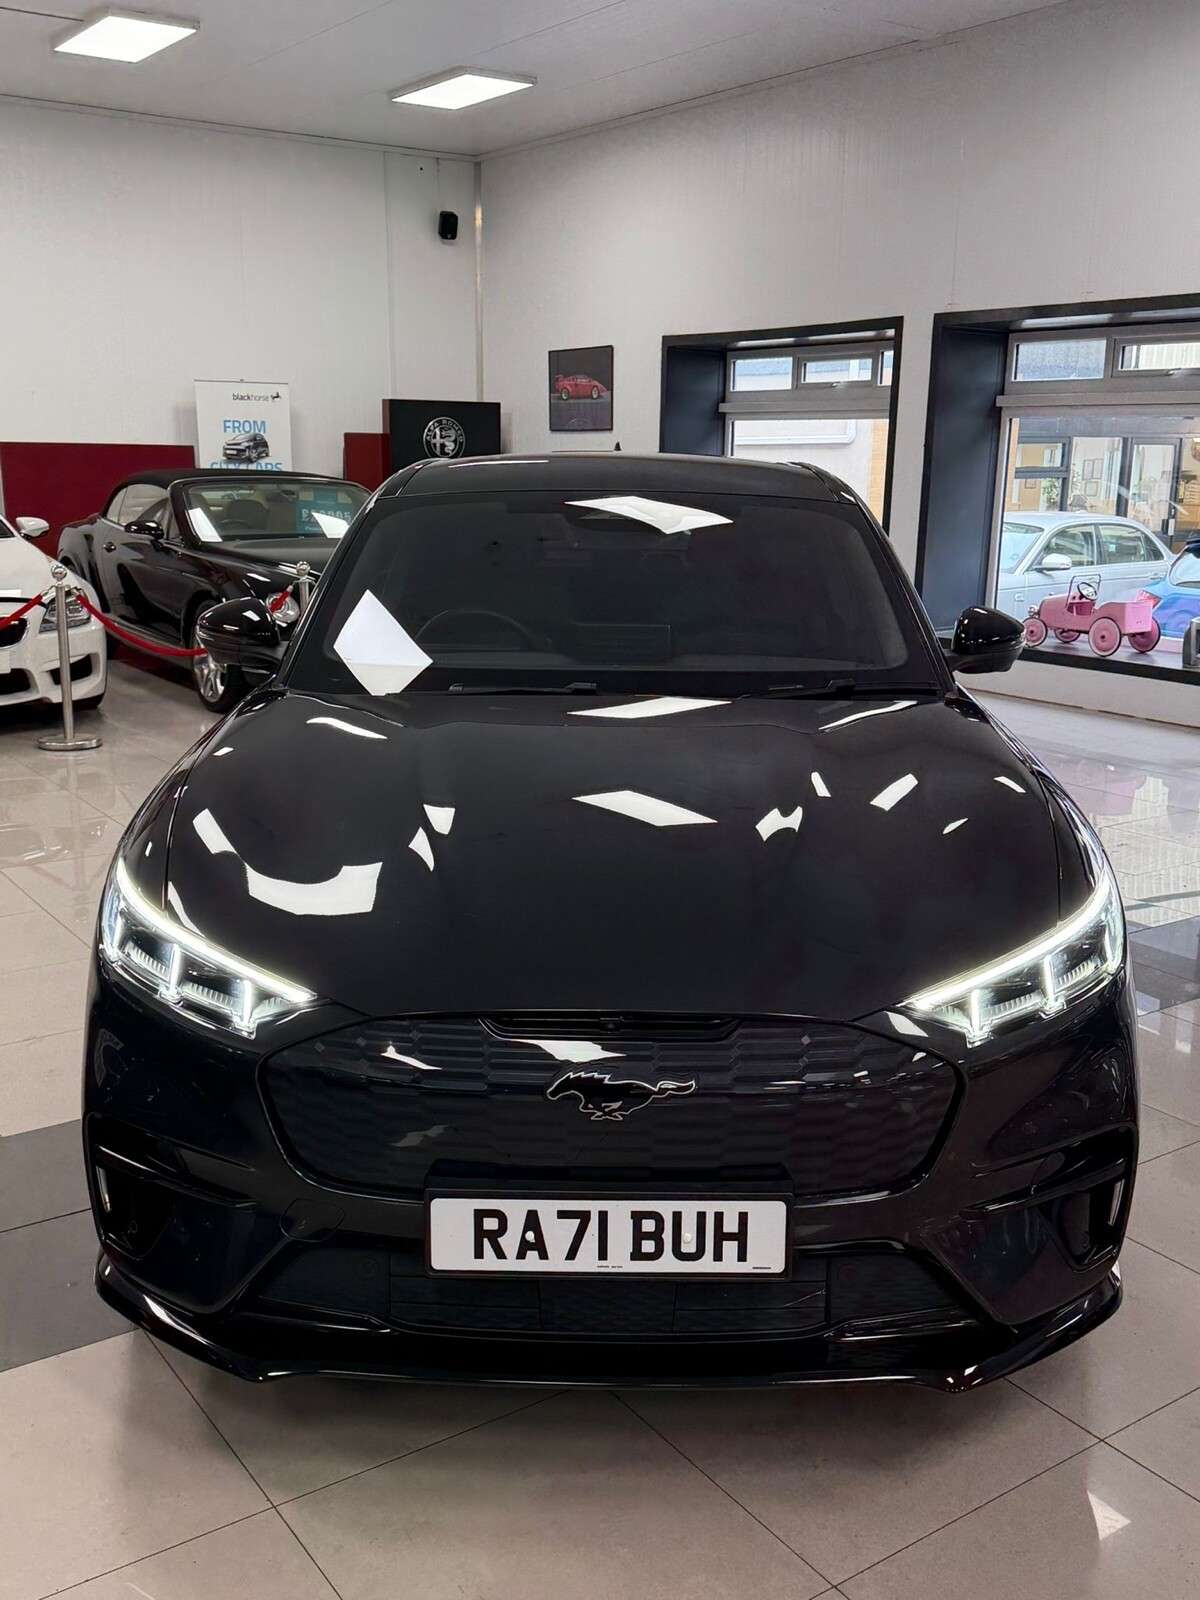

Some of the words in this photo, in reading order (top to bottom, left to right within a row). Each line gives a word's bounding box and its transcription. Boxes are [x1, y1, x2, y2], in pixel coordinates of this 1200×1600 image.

[232, 392, 269, 401] blackhorse
[223, 420, 266, 433] FROM
[473, 1208, 609, 1262] RA71
[630, 1210, 749, 1263] BUH
